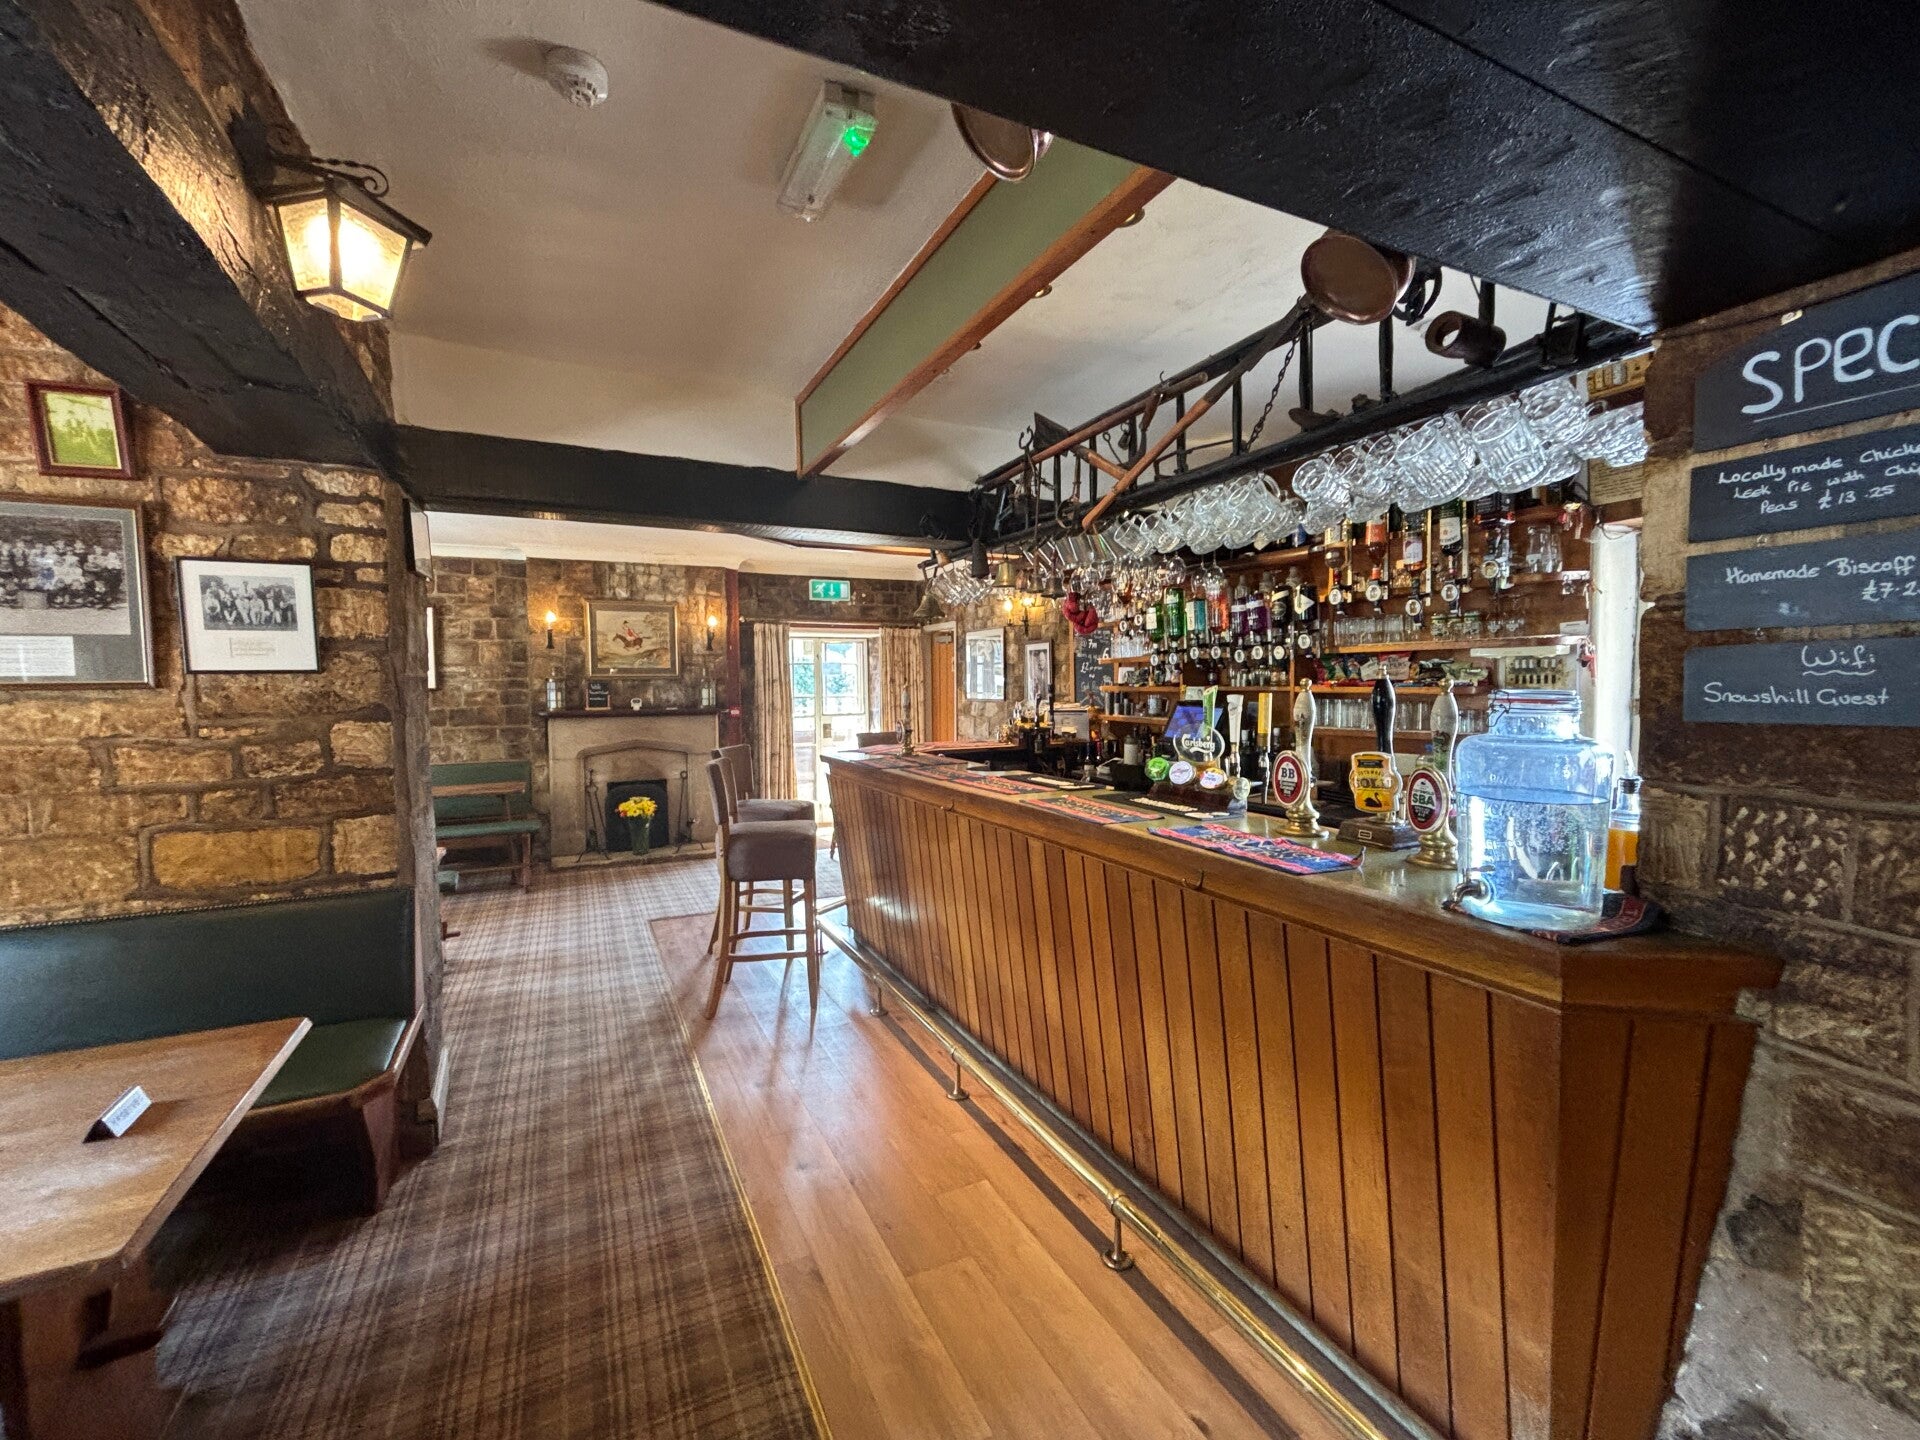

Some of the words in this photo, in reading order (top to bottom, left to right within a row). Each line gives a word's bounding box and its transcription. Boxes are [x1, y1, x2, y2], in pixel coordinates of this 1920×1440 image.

[1718, 464, 1787, 484] Locally
[1792, 456, 1843, 473] made
[1733, 486, 1771, 499] Leek
[1787, 481, 1812, 493] Pie
[1826, 470, 1864, 487] with
[1760, 500, 1798, 514] Peas
[1725, 564, 1820, 584] Homemade
[1826, 555, 1916, 576] Biscoff
[1861, 579, 1920, 602] £7.2
[1801, 645, 1876, 669] Wifi
[1703, 681, 1811, 704] Snowshill
[1816, 688, 1890, 706] Guest
[1181, 733, 1216, 753] Carlsberg
[1280, 767, 1295, 779] BB
[1412, 792, 1435, 807] SBA
